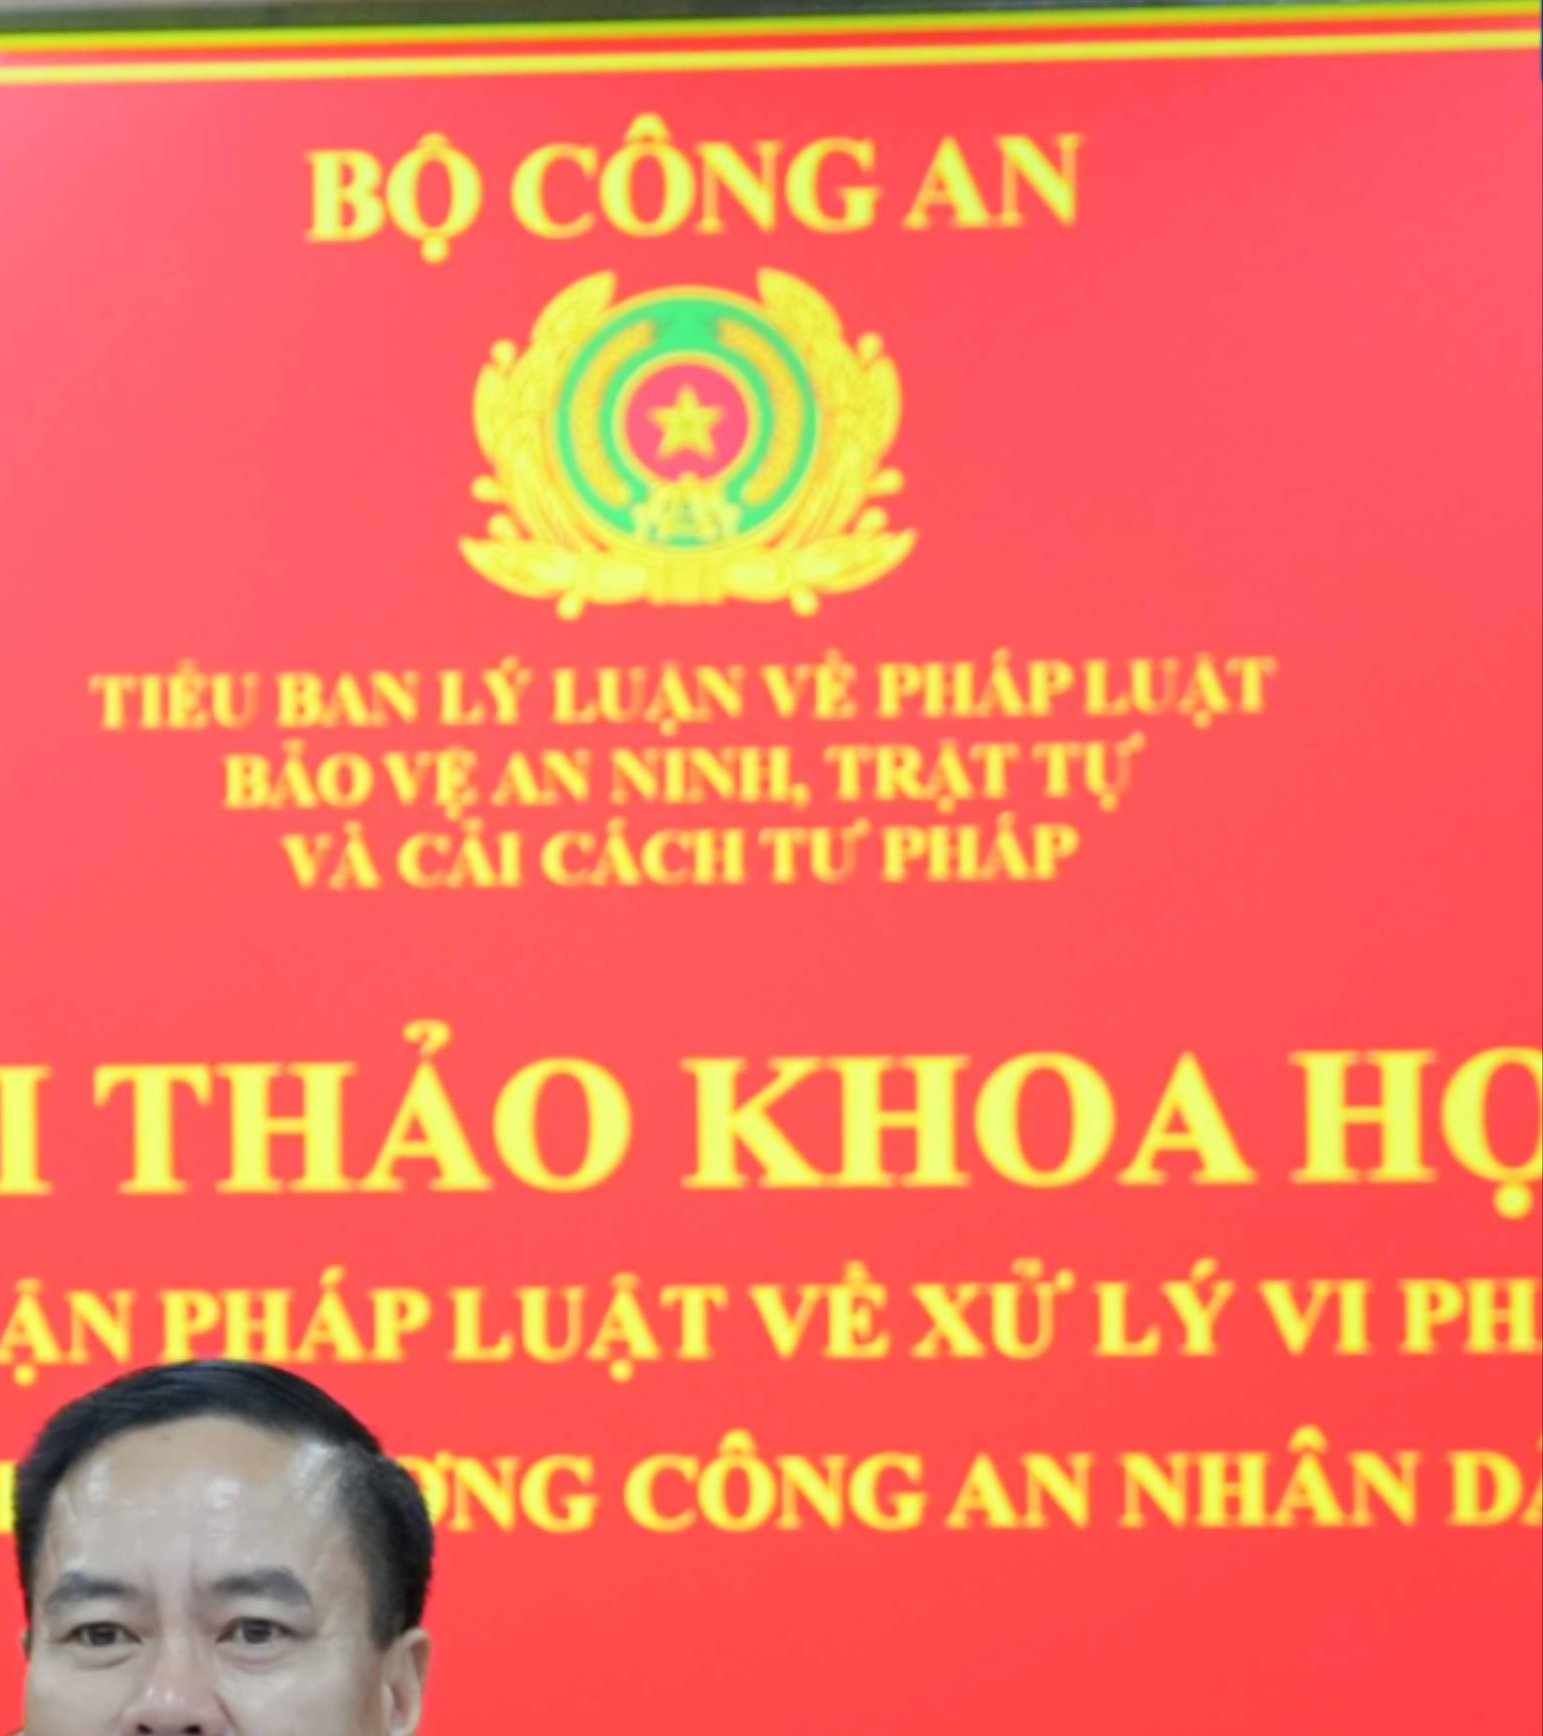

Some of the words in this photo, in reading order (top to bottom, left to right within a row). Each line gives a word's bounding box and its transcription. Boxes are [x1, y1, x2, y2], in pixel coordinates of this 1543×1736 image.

[308, 133, 482, 263] BỘ
[511, 113, 878, 238] CÔNG
[905, 134, 1079, 229] AN
[90, 661, 256, 729] TIỂU
[278, 672, 417, 727] BAN
[441, 657, 530, 725] LÝ
[554, 665, 742, 735] LUẬN
[762, 650, 855, 719] VỀ
[878, 649, 1074, 718] PHÁP
[1085, 656, 1275, 727] LUẬT
[225, 740, 373, 808] BẢO
[384, 744, 478, 822] VỆ
[492, 750, 588, 805] AN
[612, 746, 809, 805] NINH,
[825, 742, 1018, 815] TRẬT
[1033, 733, 1144, 810] TỰ
[283, 821, 379, 888] VÀ
[397, 817, 521, 887] CẢI
[541, 818, 744, 885] CÁCH
[759, 819, 869, 883] TƯ
[883, 814, 1078, 882] PHÁP
[94, 1020, 631, 1193] THẢO
[682, 1052, 1254, 1188] KHOA
[161, 1266, 431, 1363] PHÁP
[452, 1274, 727, 1381] LUẬT
[750, 1261, 889, 1358] VỀ
[913, 1259, 1074, 1358] XỬ
[1096, 1258, 1233, 1356] LÝ
[1260, 1280, 1368, 1354] VI
[624, 1429, 925, 1531] CÔNG
[946, 1453, 1090, 1528] AN
[1122, 1426, 1417, 1527] NHÂN
